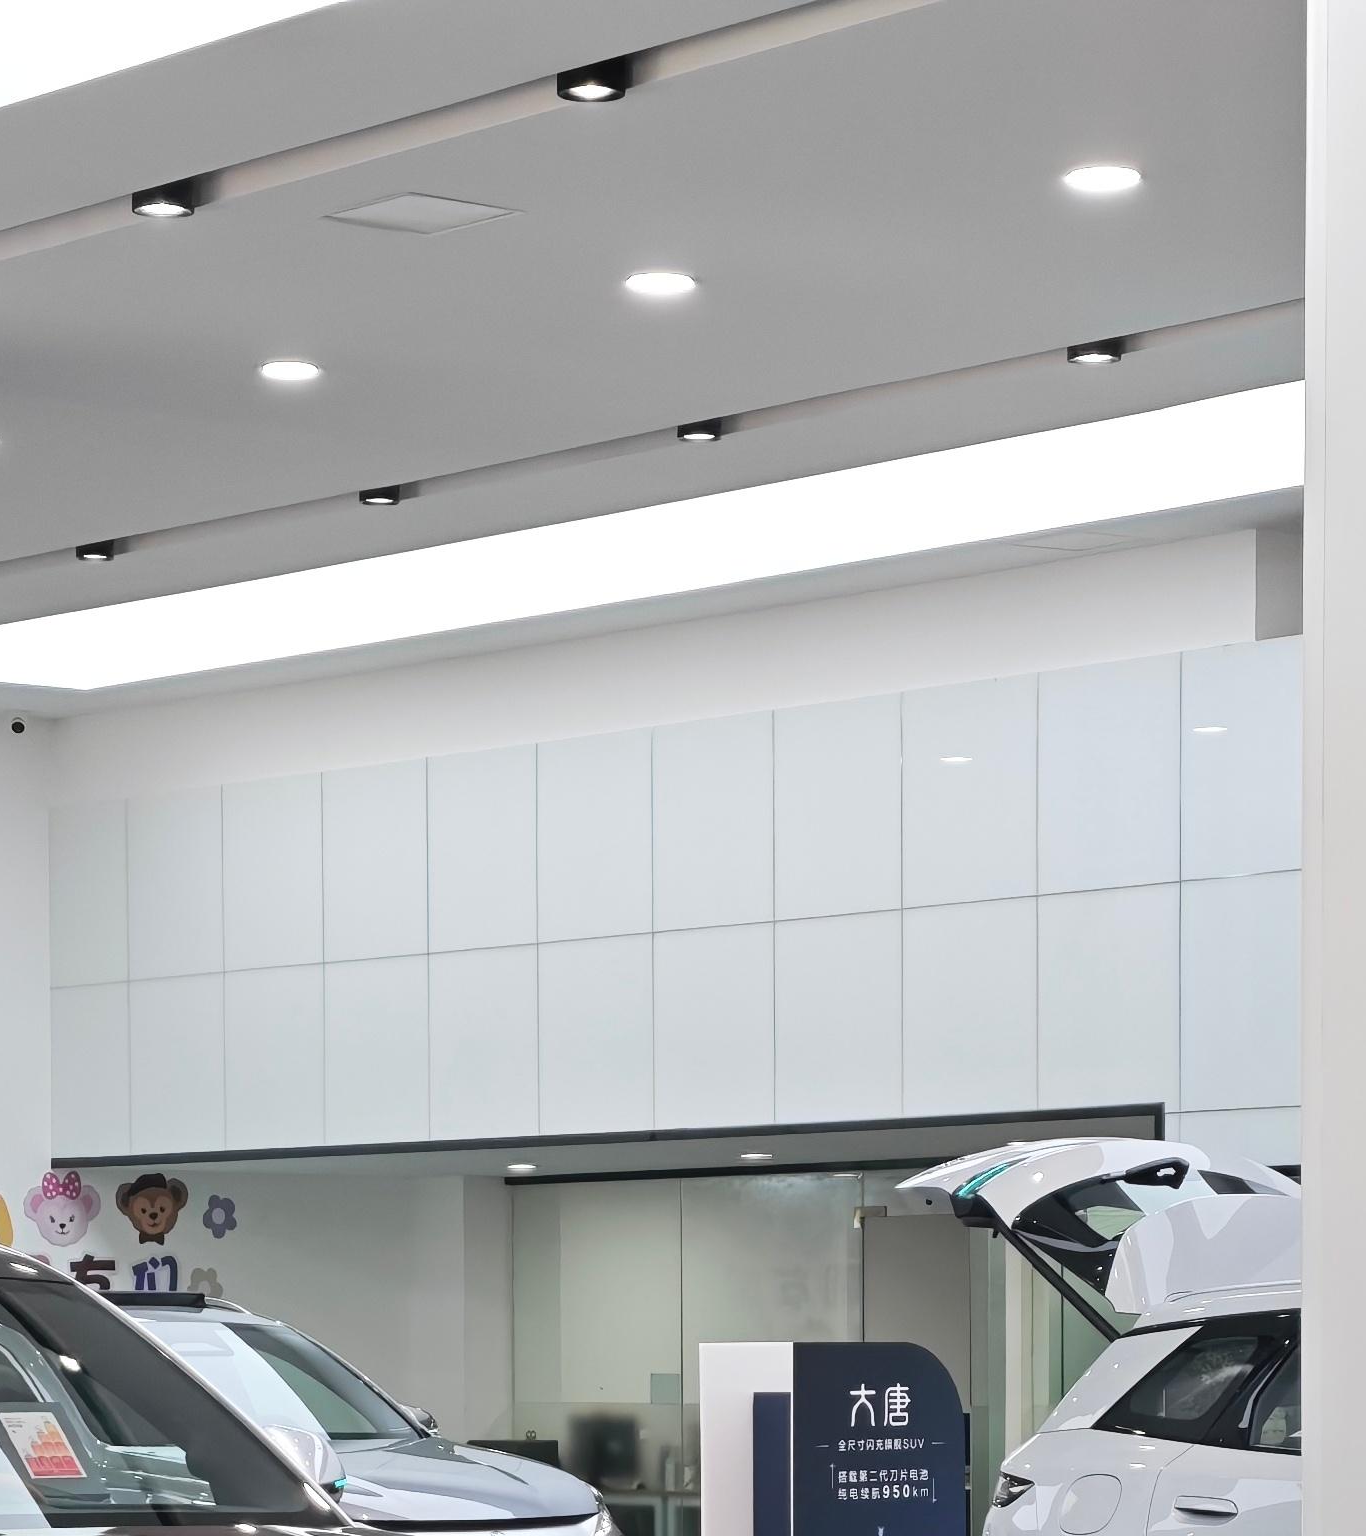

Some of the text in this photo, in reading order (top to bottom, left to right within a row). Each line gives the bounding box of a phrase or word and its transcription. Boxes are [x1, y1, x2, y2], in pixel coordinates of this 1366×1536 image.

[848, 1382, 912, 1428] 大唐
[837, 1437, 926, 1452] 全尺寸闪充旗舰SUV
[837, 1468, 930, 1483] 搭载第二代刀片电池
[837, 1484, 930, 1501] 纯电续航950km
